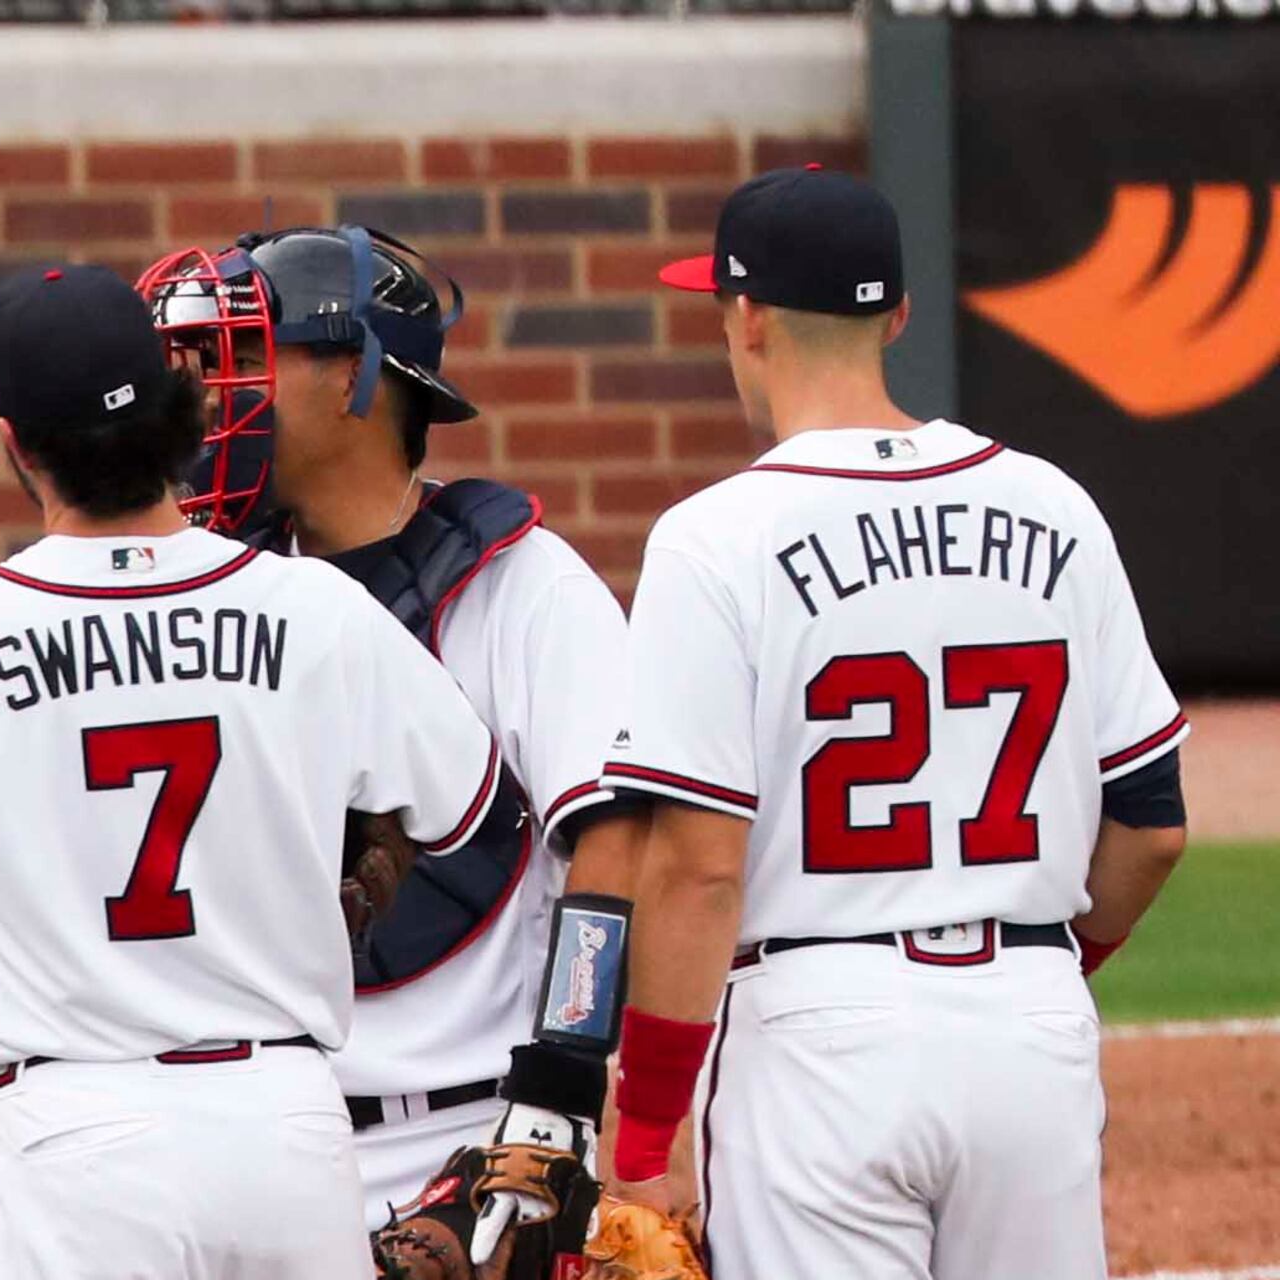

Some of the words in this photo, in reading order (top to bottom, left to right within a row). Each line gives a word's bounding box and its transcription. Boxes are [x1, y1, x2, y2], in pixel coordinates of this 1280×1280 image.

[776, 504, 1078, 617] FLAHERTY
[81, 715, 222, 941] 7
[802, 639, 1069, 874] 27
